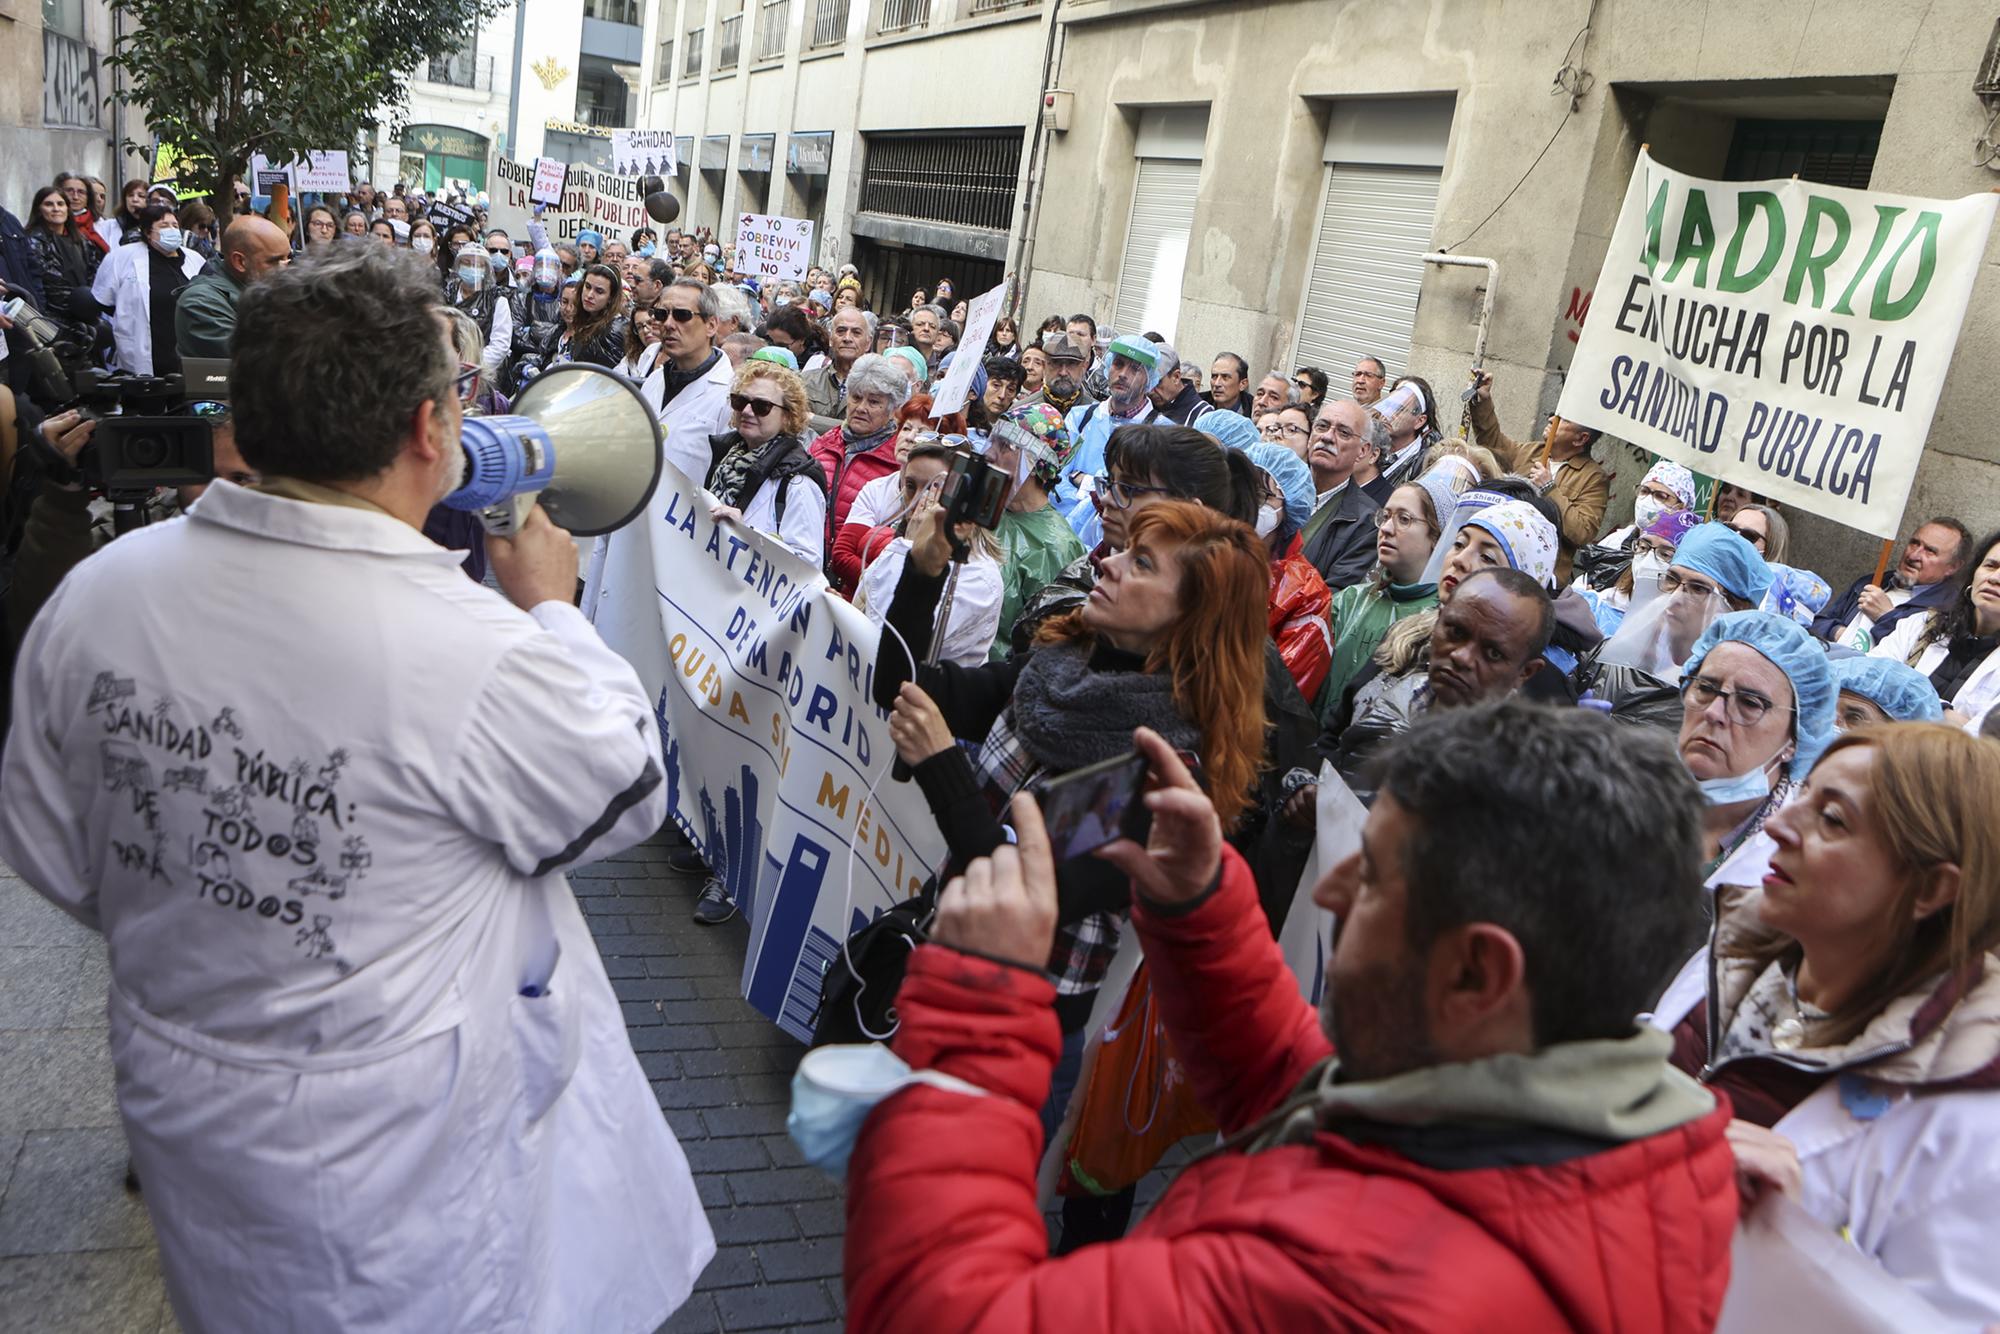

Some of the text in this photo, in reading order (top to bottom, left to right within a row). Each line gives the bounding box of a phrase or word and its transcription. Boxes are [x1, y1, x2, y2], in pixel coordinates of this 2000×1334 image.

[546, 120, 590, 134] BANCO
[630, 130, 673, 149] SANIDAD
[497, 157, 535, 188] GOBIE
[567, 169, 595, 190] QUIEN
[536, 180, 559, 193] SOS
[508, 186, 527, 209] LA
[593, 197, 649, 228] PUBLICA
[766, 219, 782, 231] YO
[740, 230, 801, 252] SOBREVIVI
[754, 245, 791, 263] ELLOS
[760, 262, 778, 275] NO
[1780, 319, 1850, 397] POR
[1858, 334, 1918, 412] LA
[1600, 355, 1883, 505] SANIDAD PUBLICA
[1473, 492, 1502, 504] Shield
[664, 491, 697, 540] LA
[705, 523, 812, 639] ATENCIÓN
[668, 632, 750, 726] QUEDA
[725, 605, 871, 768] DE MADRID
[103, 702, 213, 761] SANIDAD
